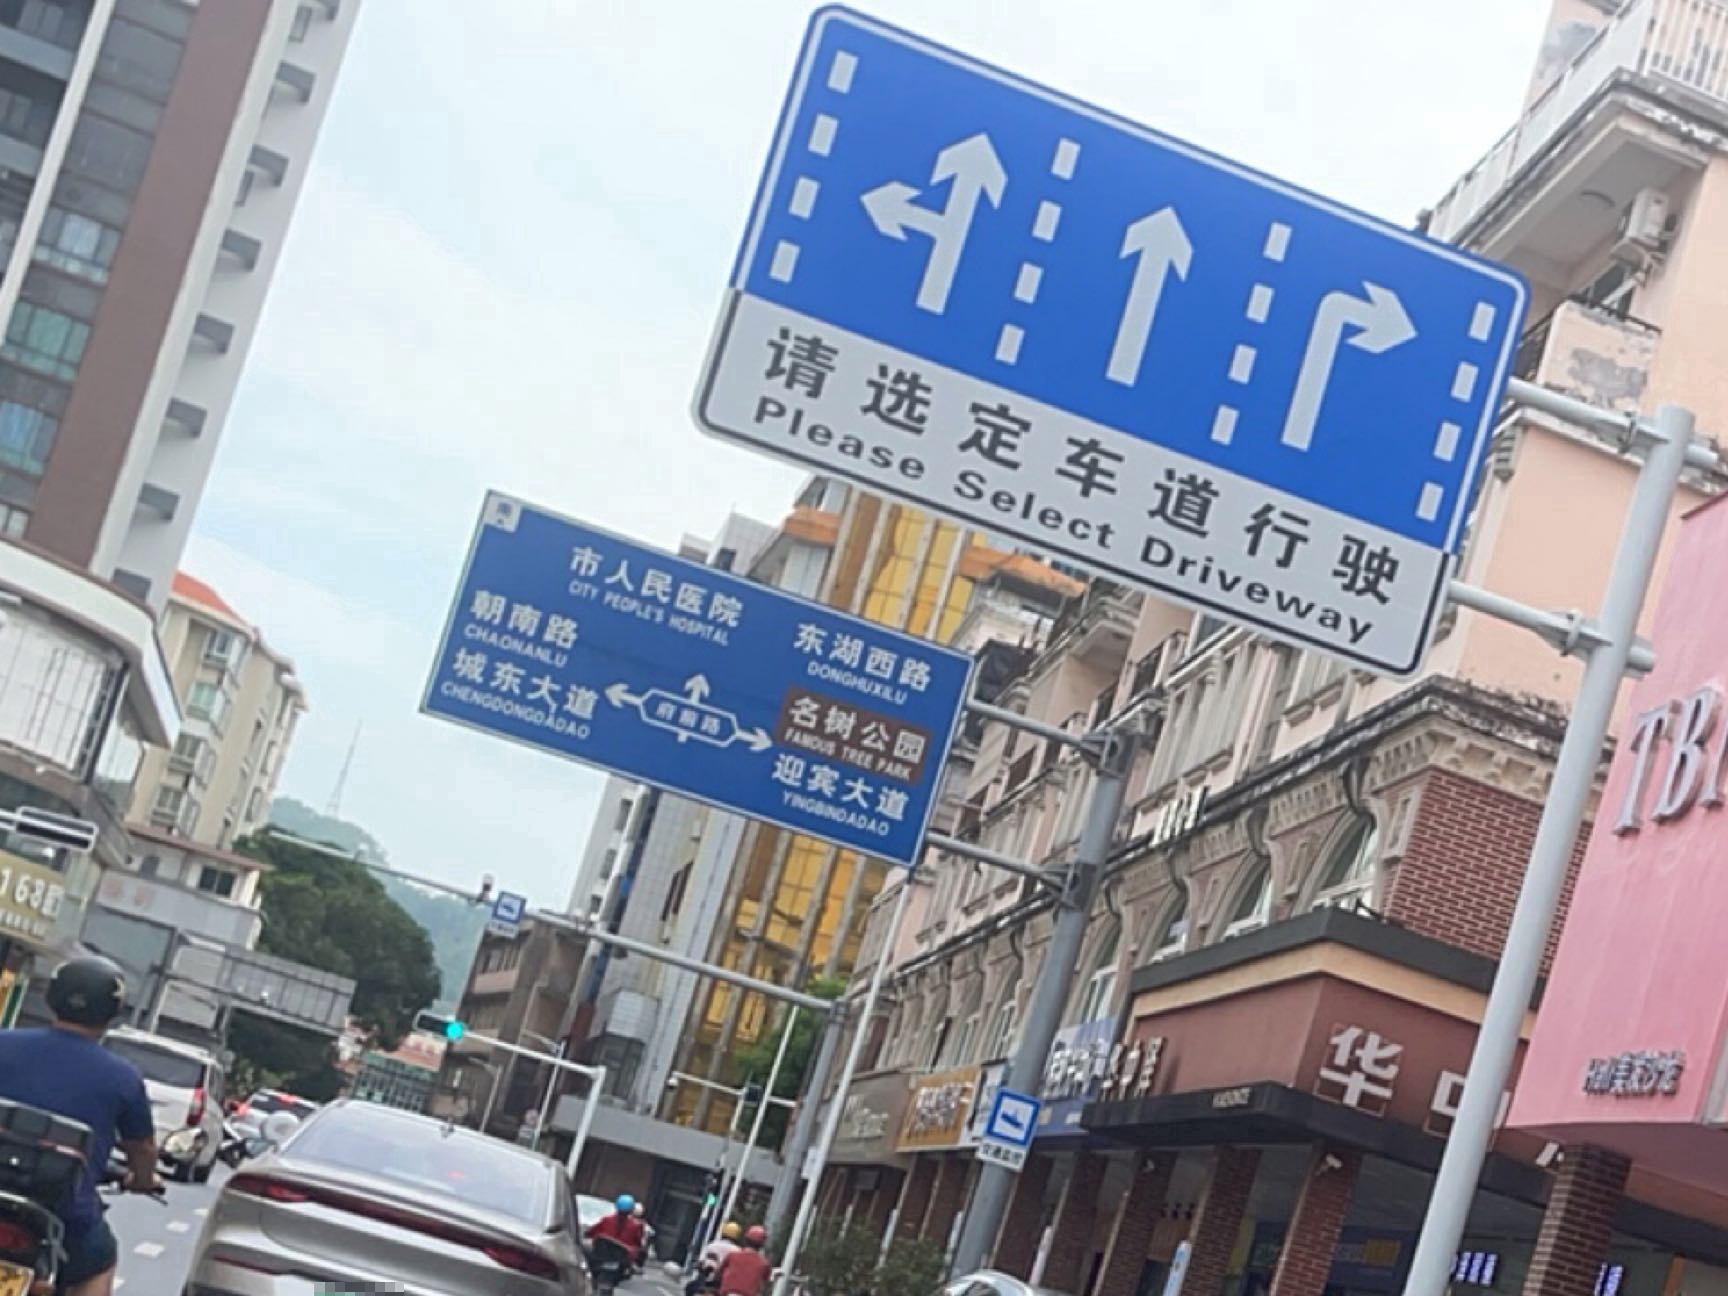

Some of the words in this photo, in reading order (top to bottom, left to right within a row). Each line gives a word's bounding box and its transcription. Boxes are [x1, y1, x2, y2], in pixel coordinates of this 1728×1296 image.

[763, 325, 1402, 606] 请选定车道行驶
[754, 395, 927, 482] Please
[953, 470, 1115, 552] Select
[1141, 536, 1377, 646] Driveway
[468, 589, 581, 651] 朝南路
[568, 580, 600, 602] CITY
[669, 612, 729, 648] HOSPITAL
[569, 546, 745, 628] 市人民医院
[463, 623, 569, 669] CHAONANLU
[793, 622, 934, 693] 东湖西路
[440, 682, 591, 741] CHENGDONGDADAO
[451, 648, 601, 721] 城东大道
[807, 661, 909, 706] DONGHUXILU
[783, 727, 837, 758] FAMOUS
[841, 743, 874, 769] TREE
[876, 752, 912, 781] PARK
[788, 697, 925, 766] 名树公园
[770, 753, 911, 822] 迎宾大道
